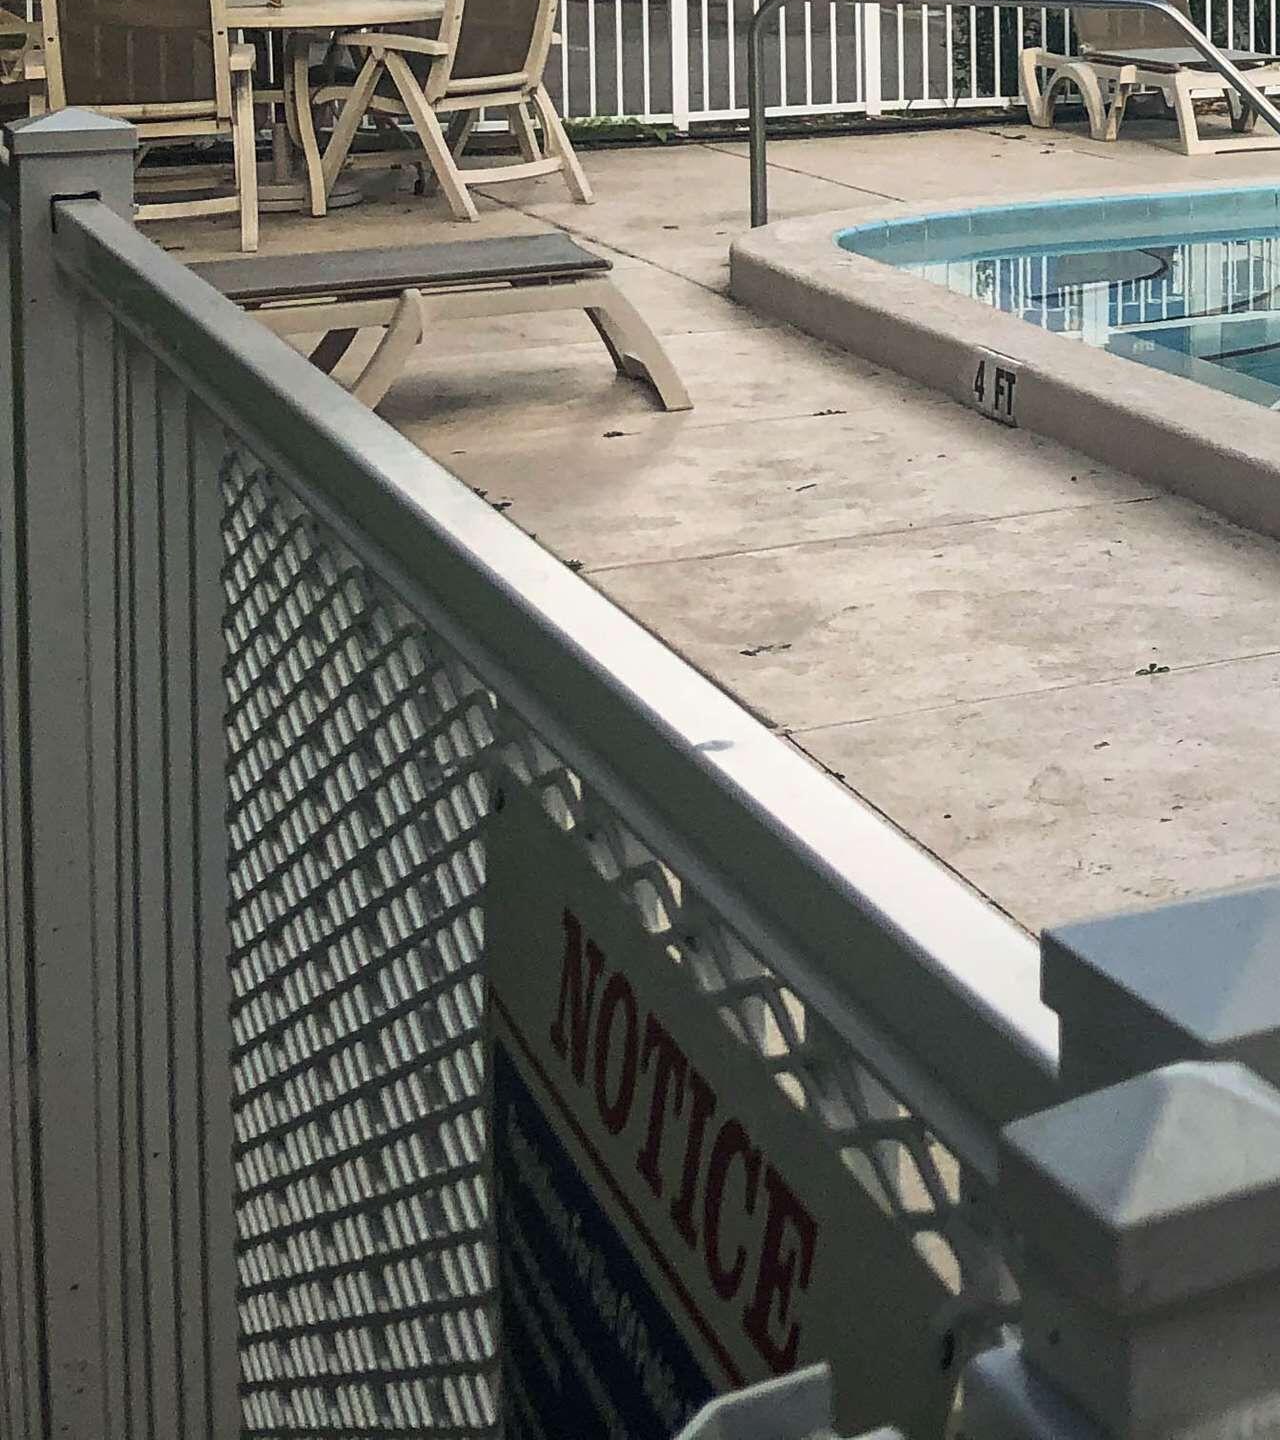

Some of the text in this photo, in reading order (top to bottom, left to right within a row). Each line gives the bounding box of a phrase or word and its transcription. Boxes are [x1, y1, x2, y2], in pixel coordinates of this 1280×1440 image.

[974, 360, 1016, 416] 4 FT
[549, 906, 818, 1375] NOTICE
